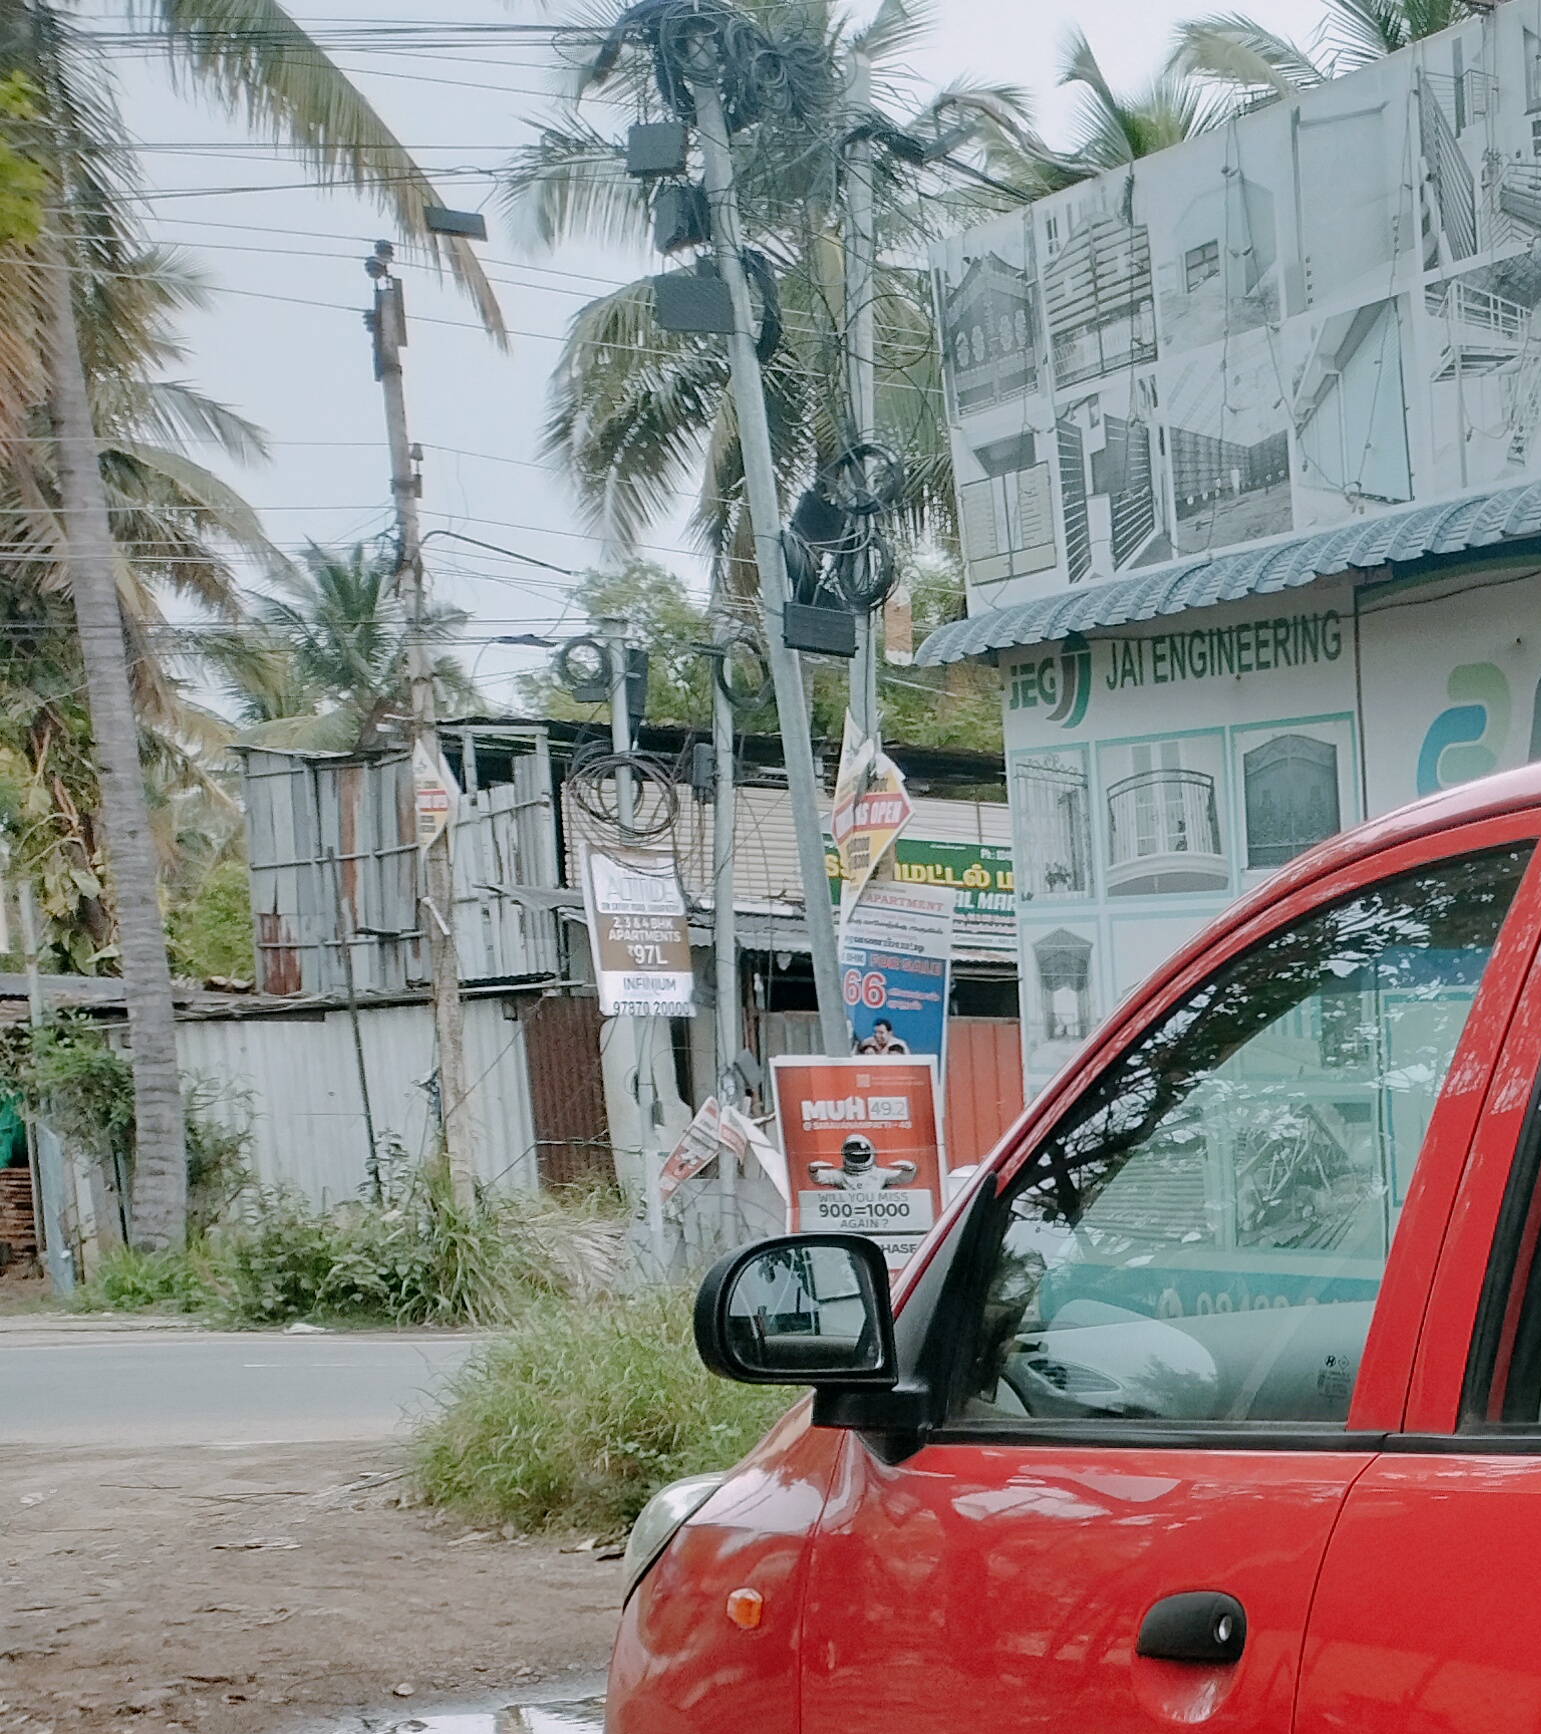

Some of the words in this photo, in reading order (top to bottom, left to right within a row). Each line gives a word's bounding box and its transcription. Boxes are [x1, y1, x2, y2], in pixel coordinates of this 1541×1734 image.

[1106, 638, 1145, 691] JAI
[1153, 609, 1342, 685] ENGINEERING
[608, 929, 681, 942] APARTMENTS
[817, 1193, 847, 1202] WILL
[849, 1193, 874, 1202] YOU
[878, 1192, 908, 1201] MISS
[818, 1203, 910, 1218] 900=1000
[840, 1219, 879, 1228] AGAIN
